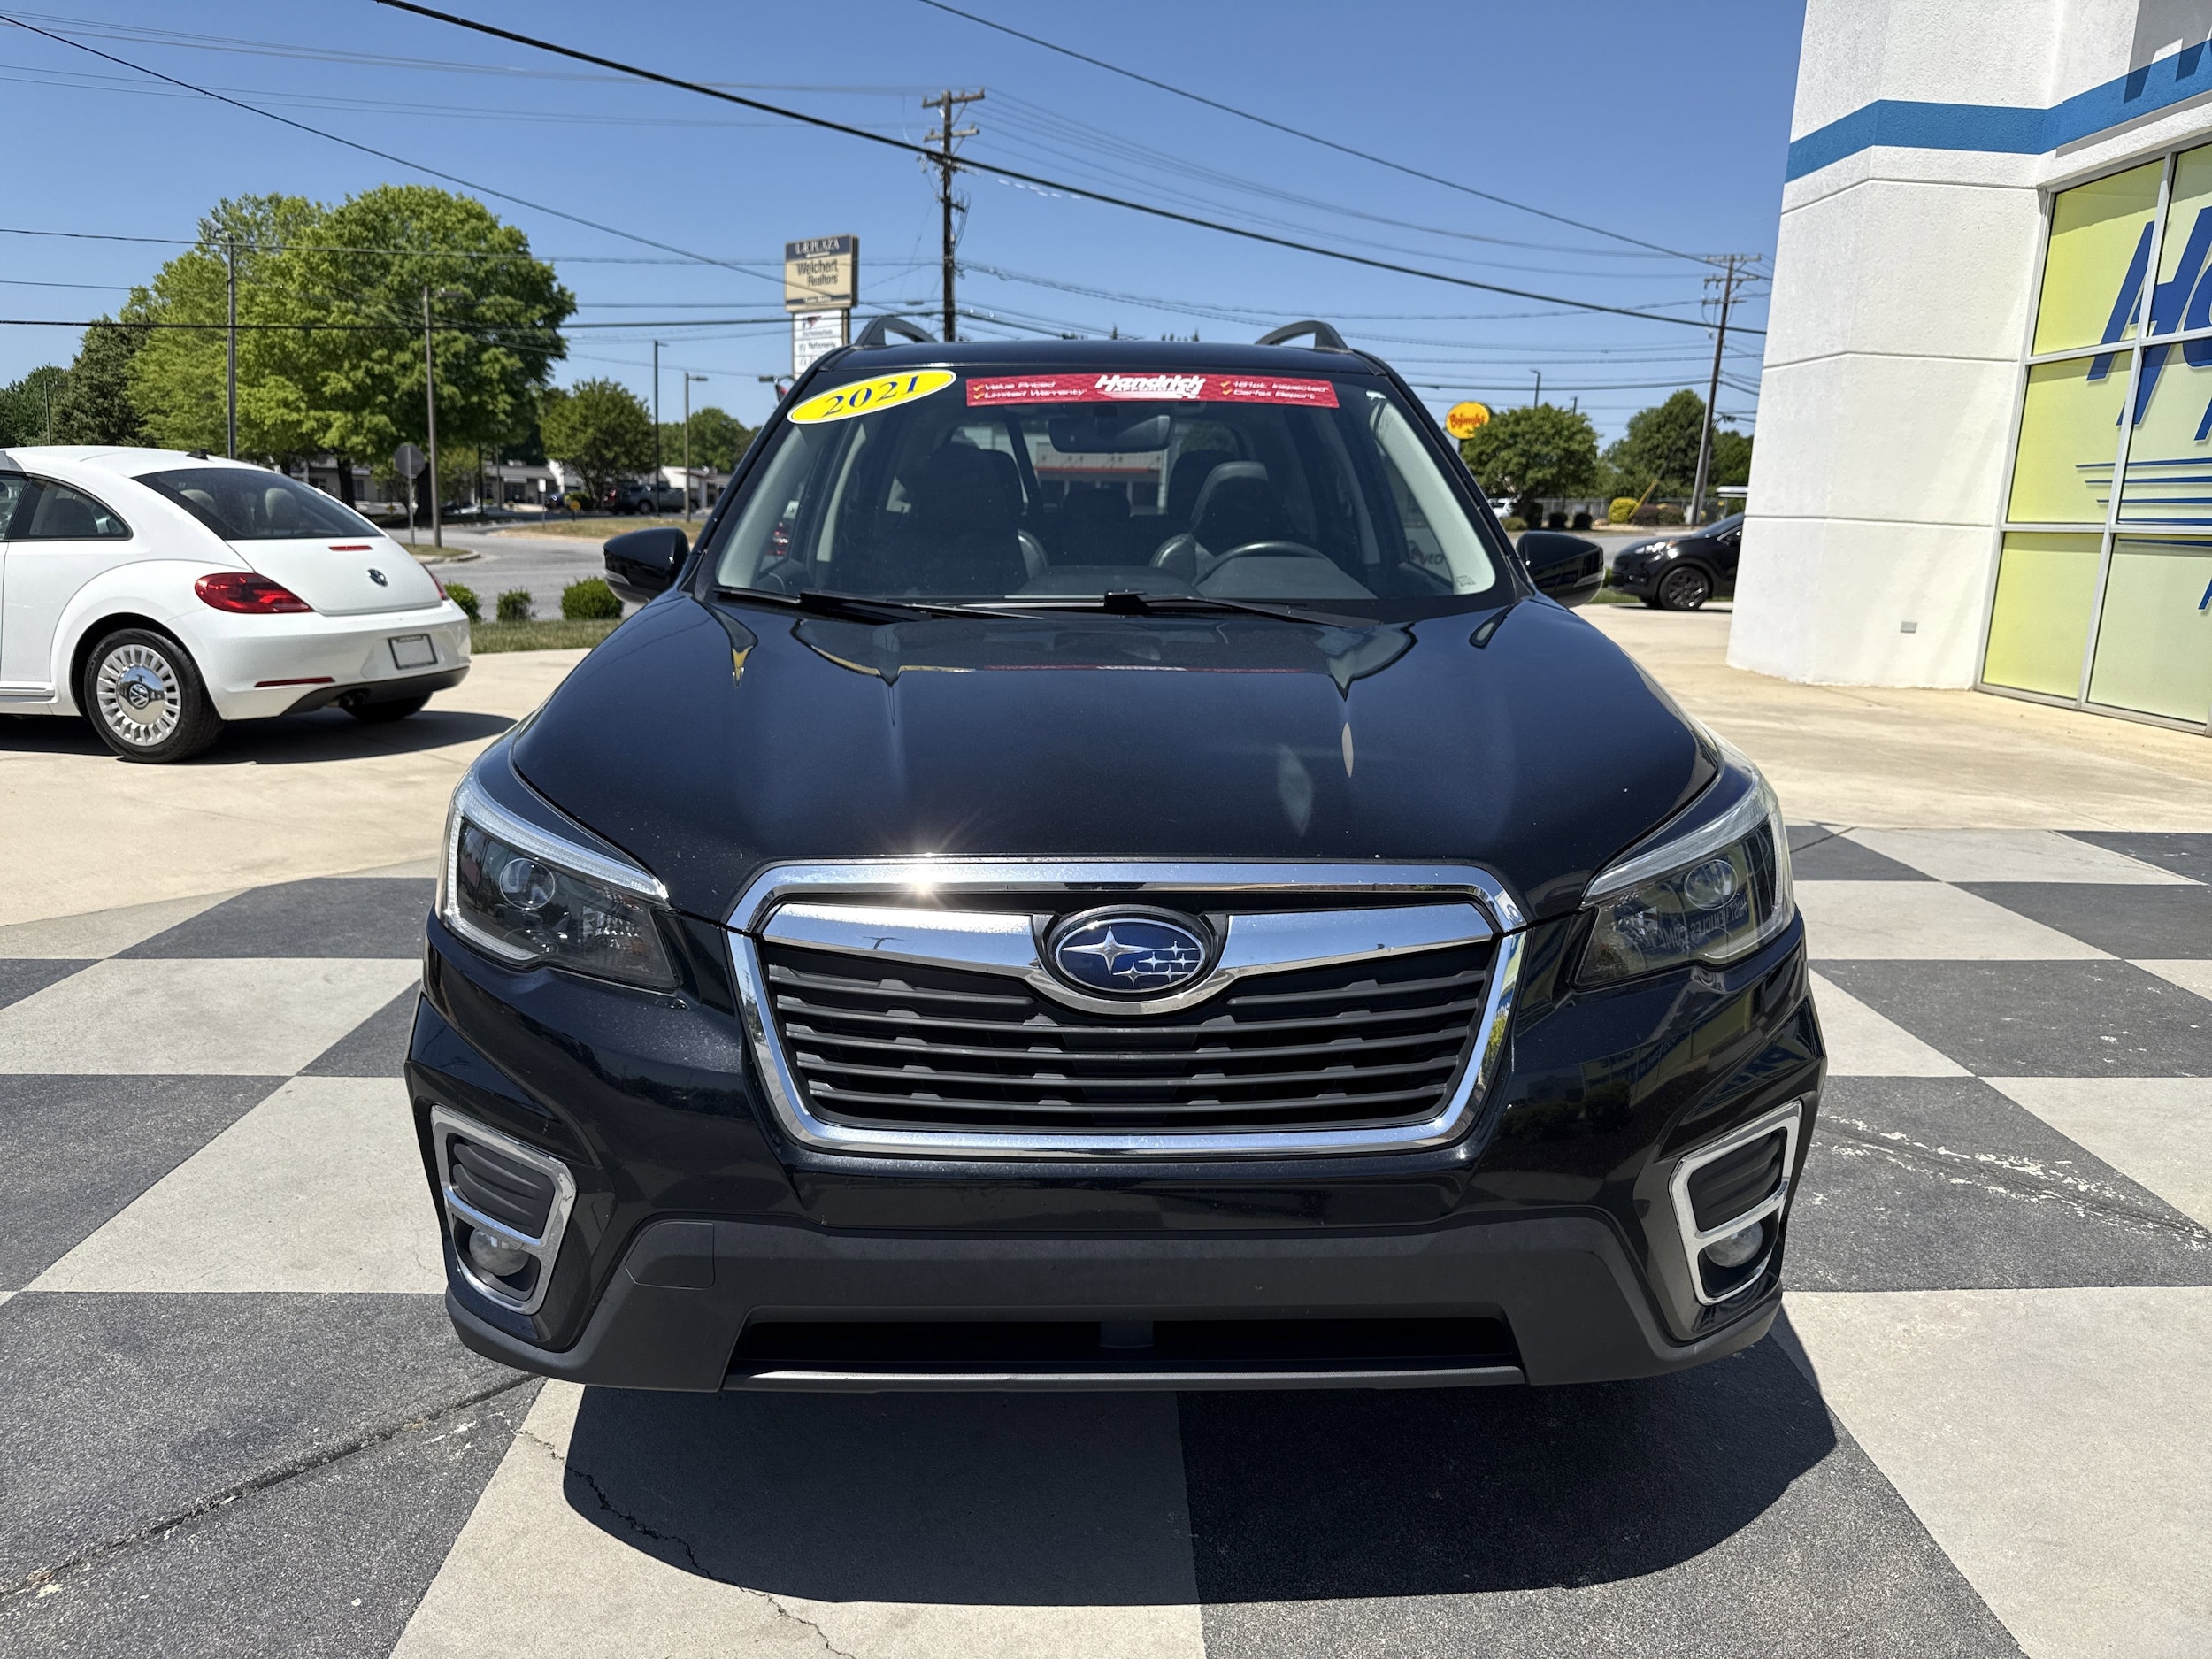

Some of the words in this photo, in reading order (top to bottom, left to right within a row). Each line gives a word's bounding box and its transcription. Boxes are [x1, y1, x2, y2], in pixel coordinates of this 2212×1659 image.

[985, 382, 1015, 391] Value
[1094, 374, 1206, 395] Hendrick
[821, 375, 920, 418] 2021
[984, 390, 1027, 399] Limited
[1233, 388, 1272, 397] Carfax
[1275, 390, 1316, 400] Report
